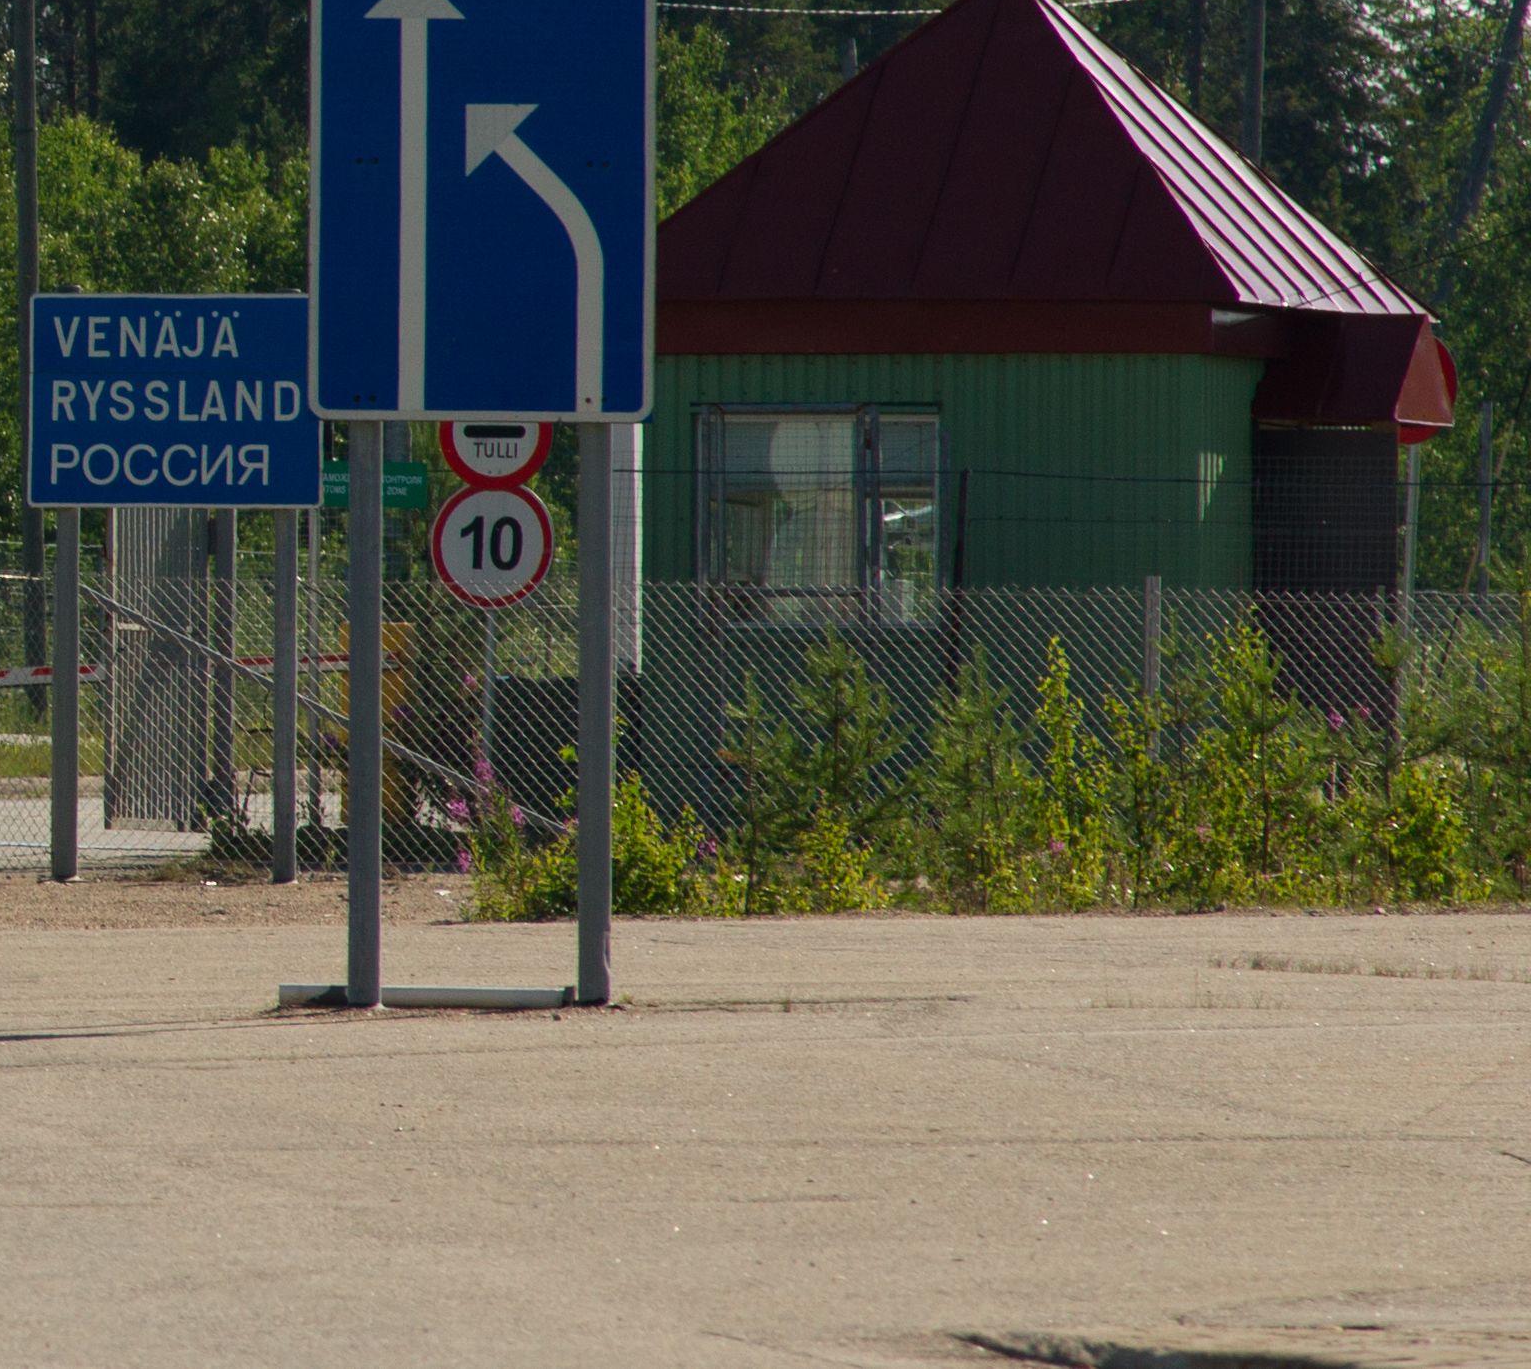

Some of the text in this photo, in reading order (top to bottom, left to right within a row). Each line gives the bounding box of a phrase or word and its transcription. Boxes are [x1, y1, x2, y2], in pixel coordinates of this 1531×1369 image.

[53, 310, 240, 358] VENÄJÄ
[51, 379, 302, 422] RYSSLAND
[50, 443, 270, 487] РОССИЯ
[473, 442, 518, 459] TULLI
[460, 515, 524, 571] 10
